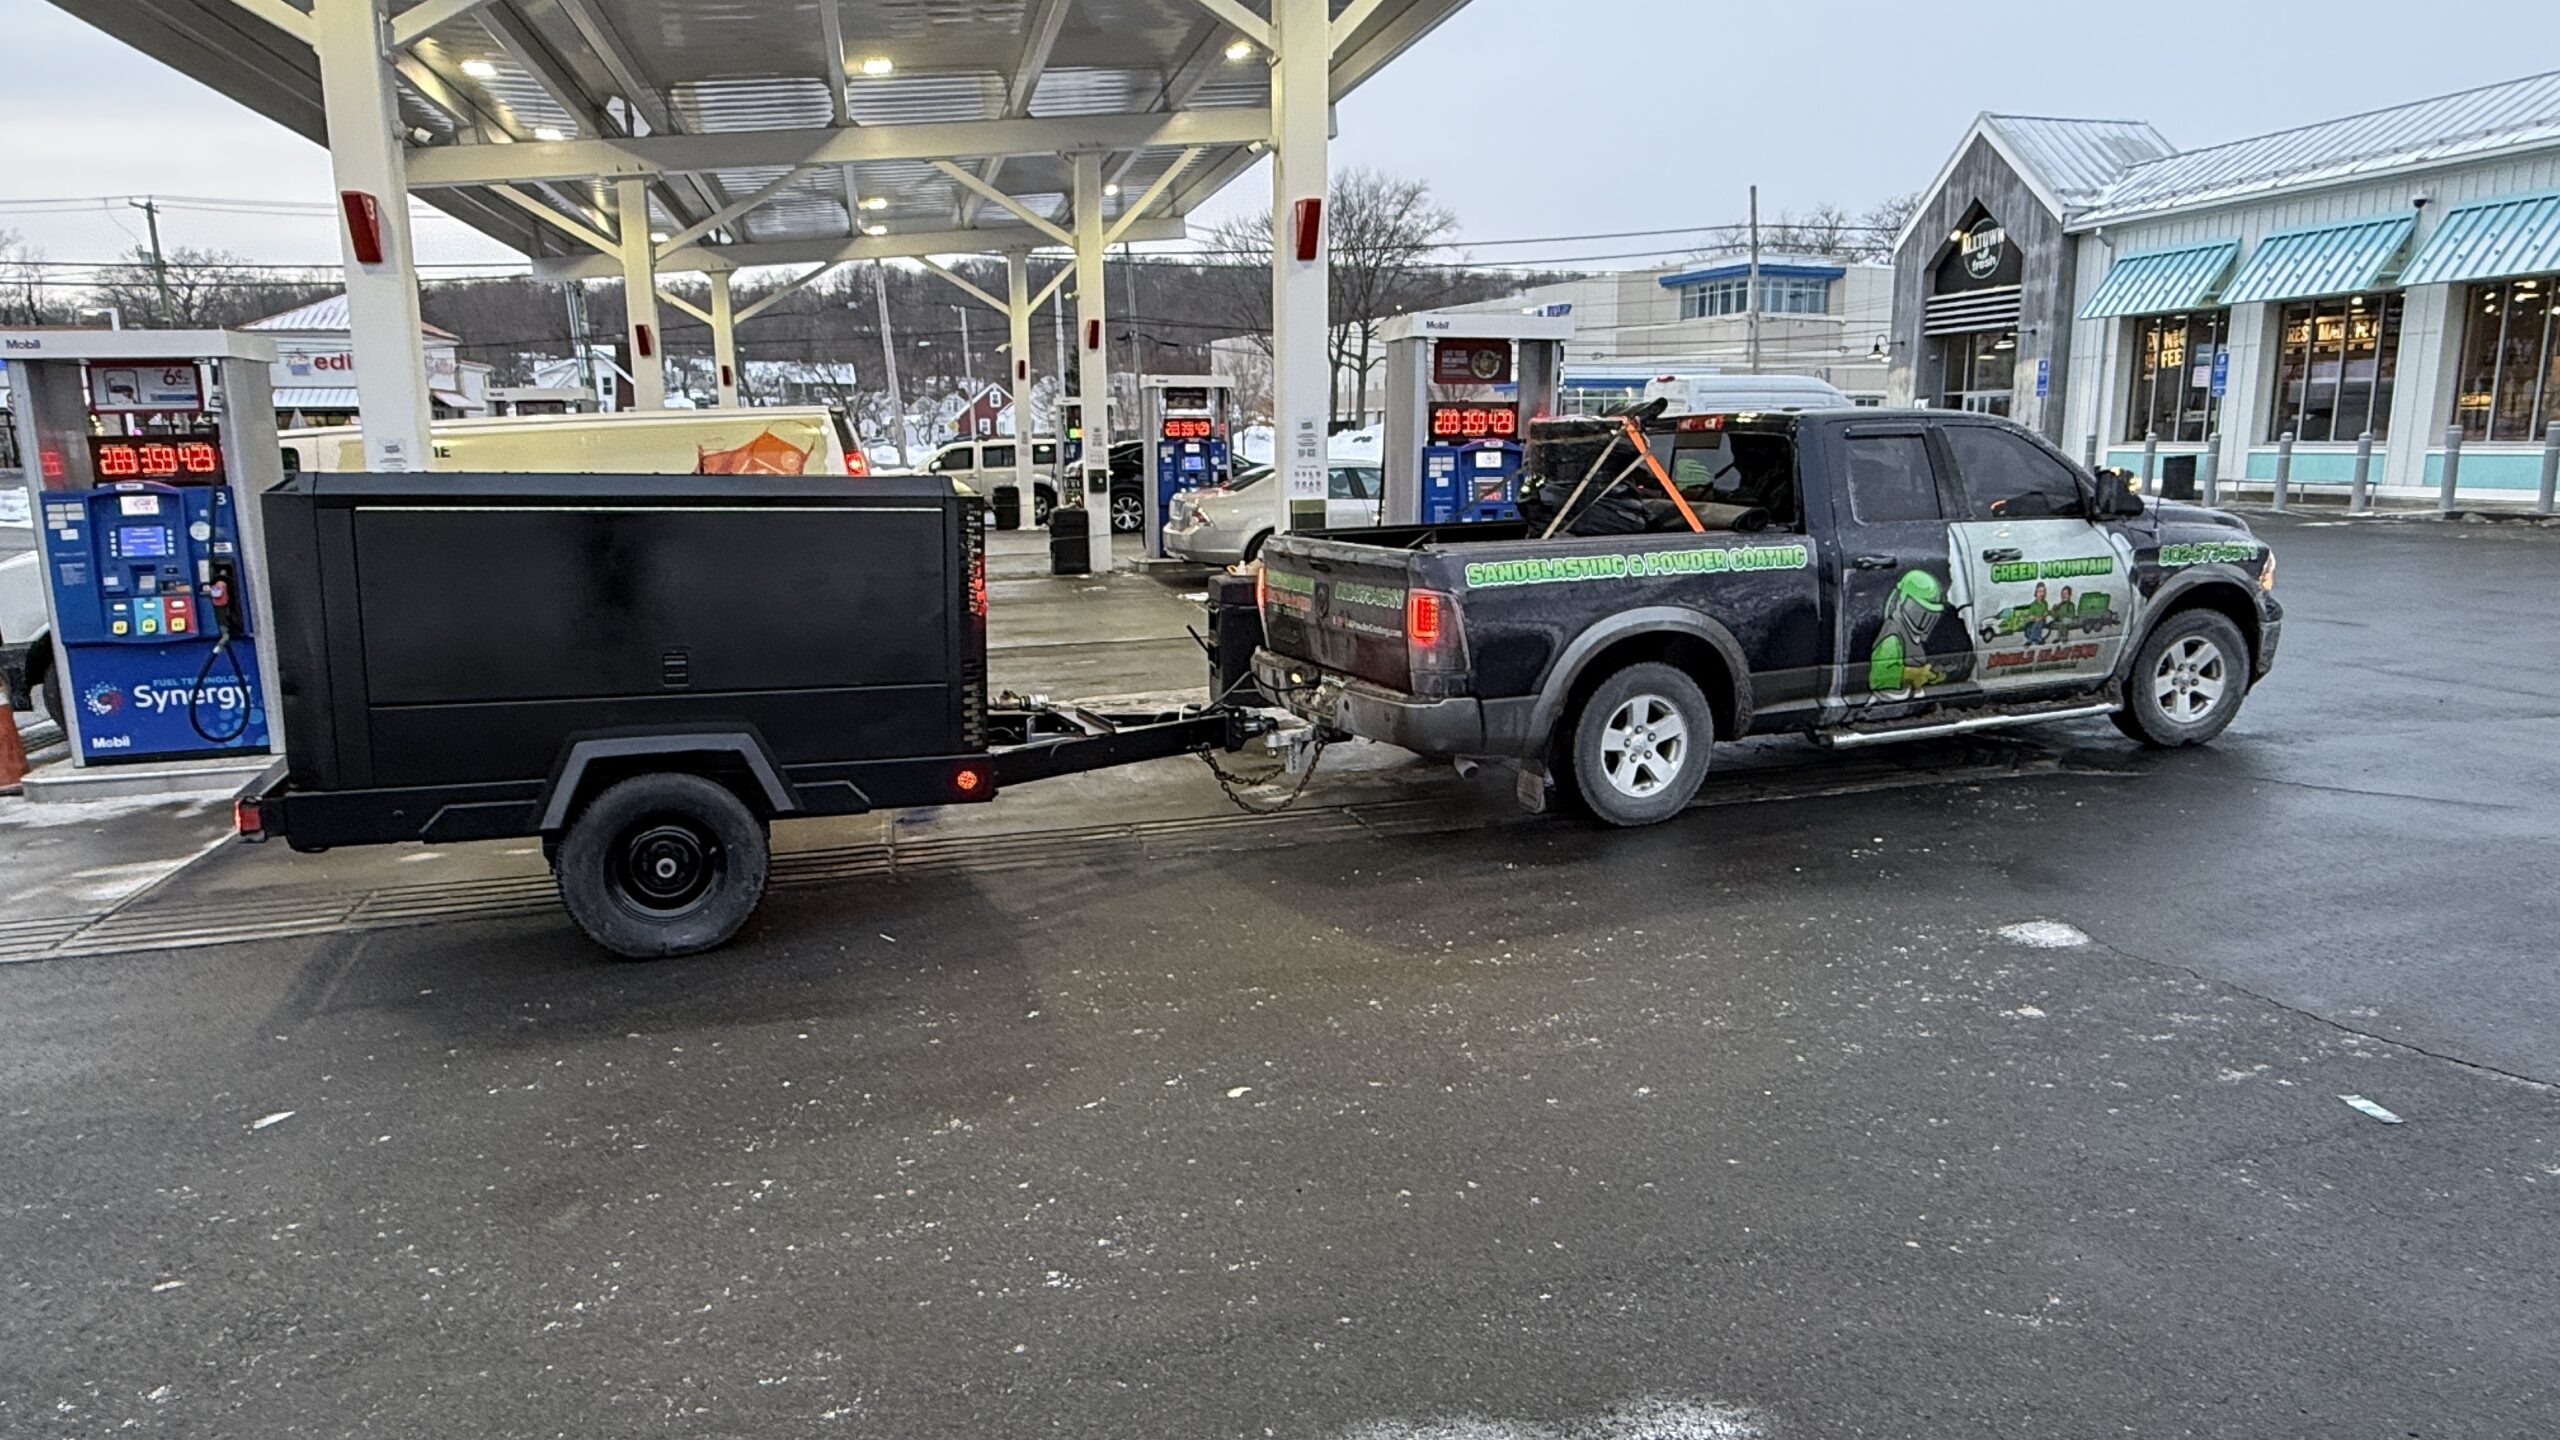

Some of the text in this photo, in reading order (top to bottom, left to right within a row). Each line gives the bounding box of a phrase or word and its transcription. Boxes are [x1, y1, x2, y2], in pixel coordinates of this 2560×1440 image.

[1961, 227, 2005, 256] ALLTOWN
[1972, 255, 1996, 271] fresh
[1426, 321, 1450, 330] Mobil
[6, 339, 41, 349] Mobil
[314, 353, 353, 370] edi
[216, 492, 227, 505] 3
[1465, 554, 1627, 587] SANDBLASTING
[1644, 549, 1729, 576] POWDER
[1729, 545, 1807, 571] COATING
[1991, 556, 2113, 583] GREEN MOUNTAIN
[153, 678, 179, 687] FUEL
[133, 684, 252, 714] Synergy
[92, 736, 131, 749] Mobil
